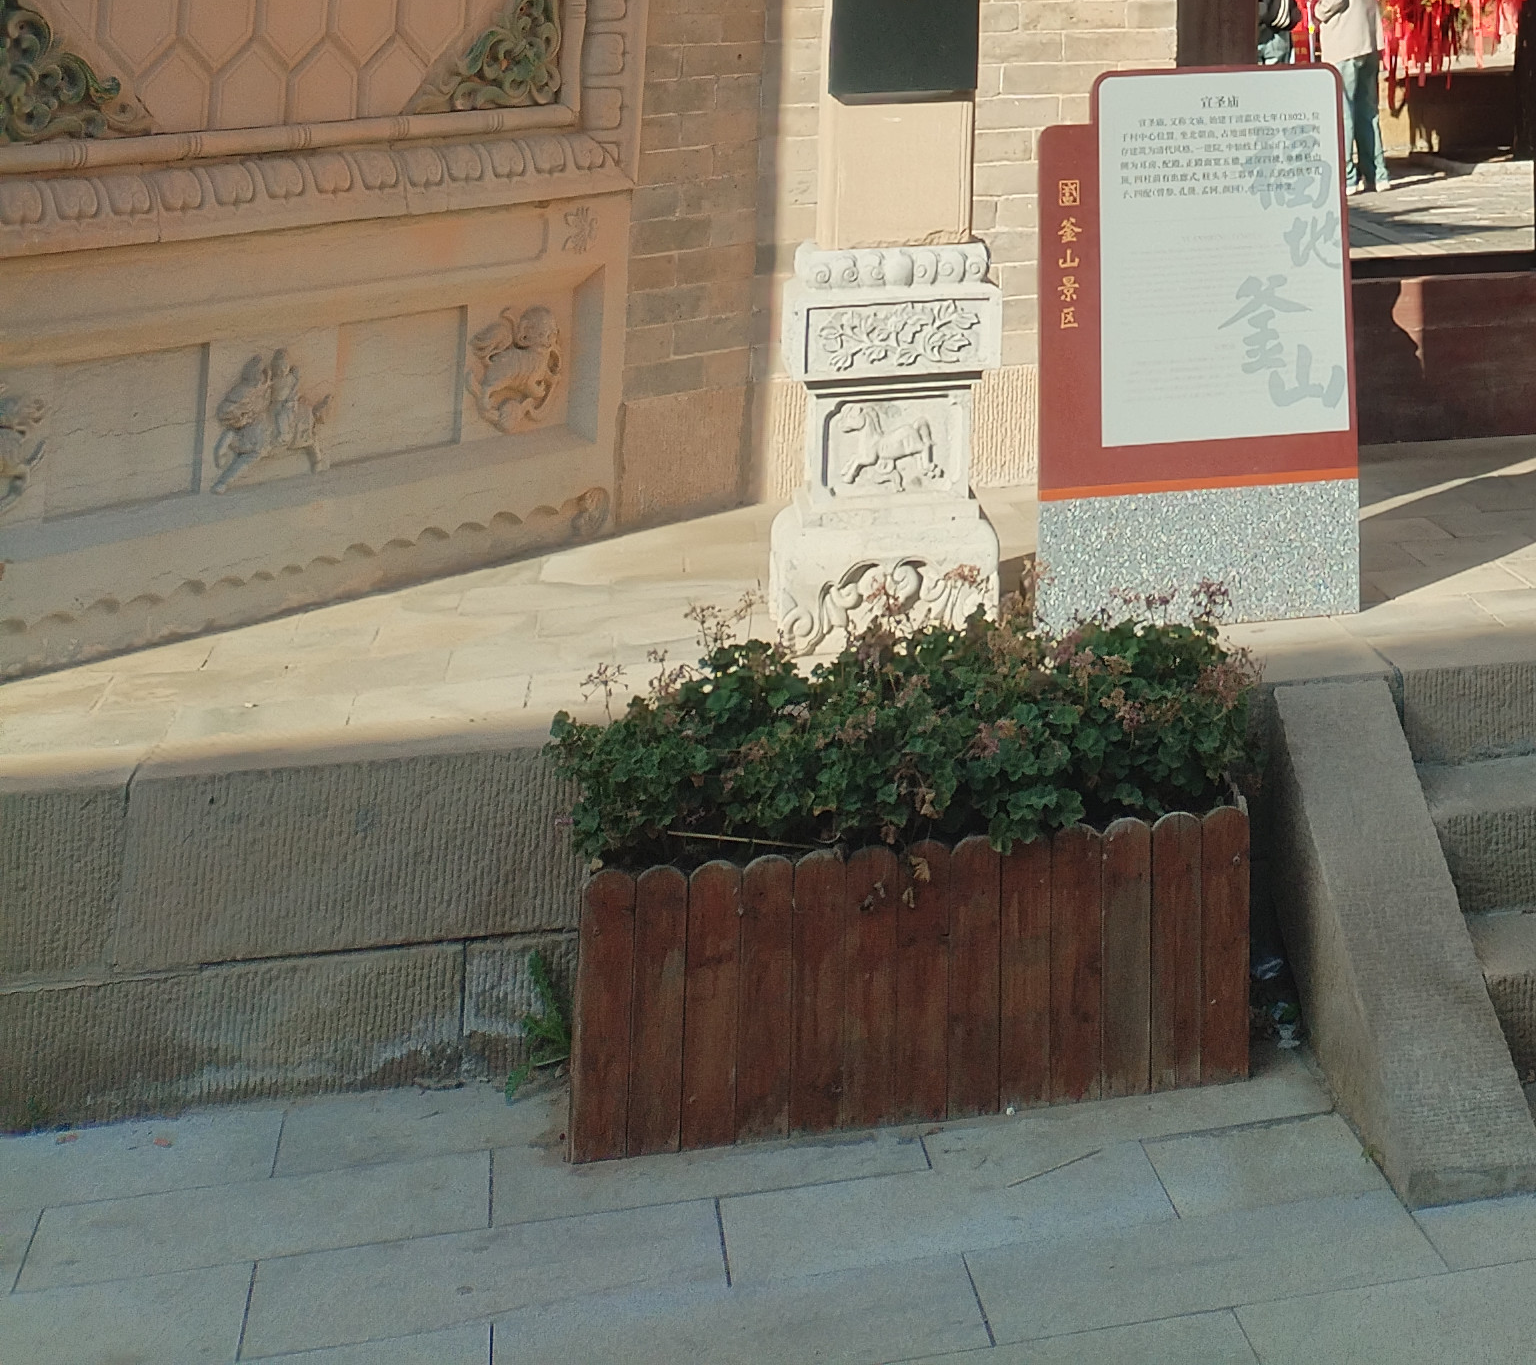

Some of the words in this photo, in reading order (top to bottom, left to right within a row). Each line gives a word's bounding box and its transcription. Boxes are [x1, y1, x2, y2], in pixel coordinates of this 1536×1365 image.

[1057, 217, 1083, 329] 釜山景区
[1217, 275, 1345, 409] 釜山
